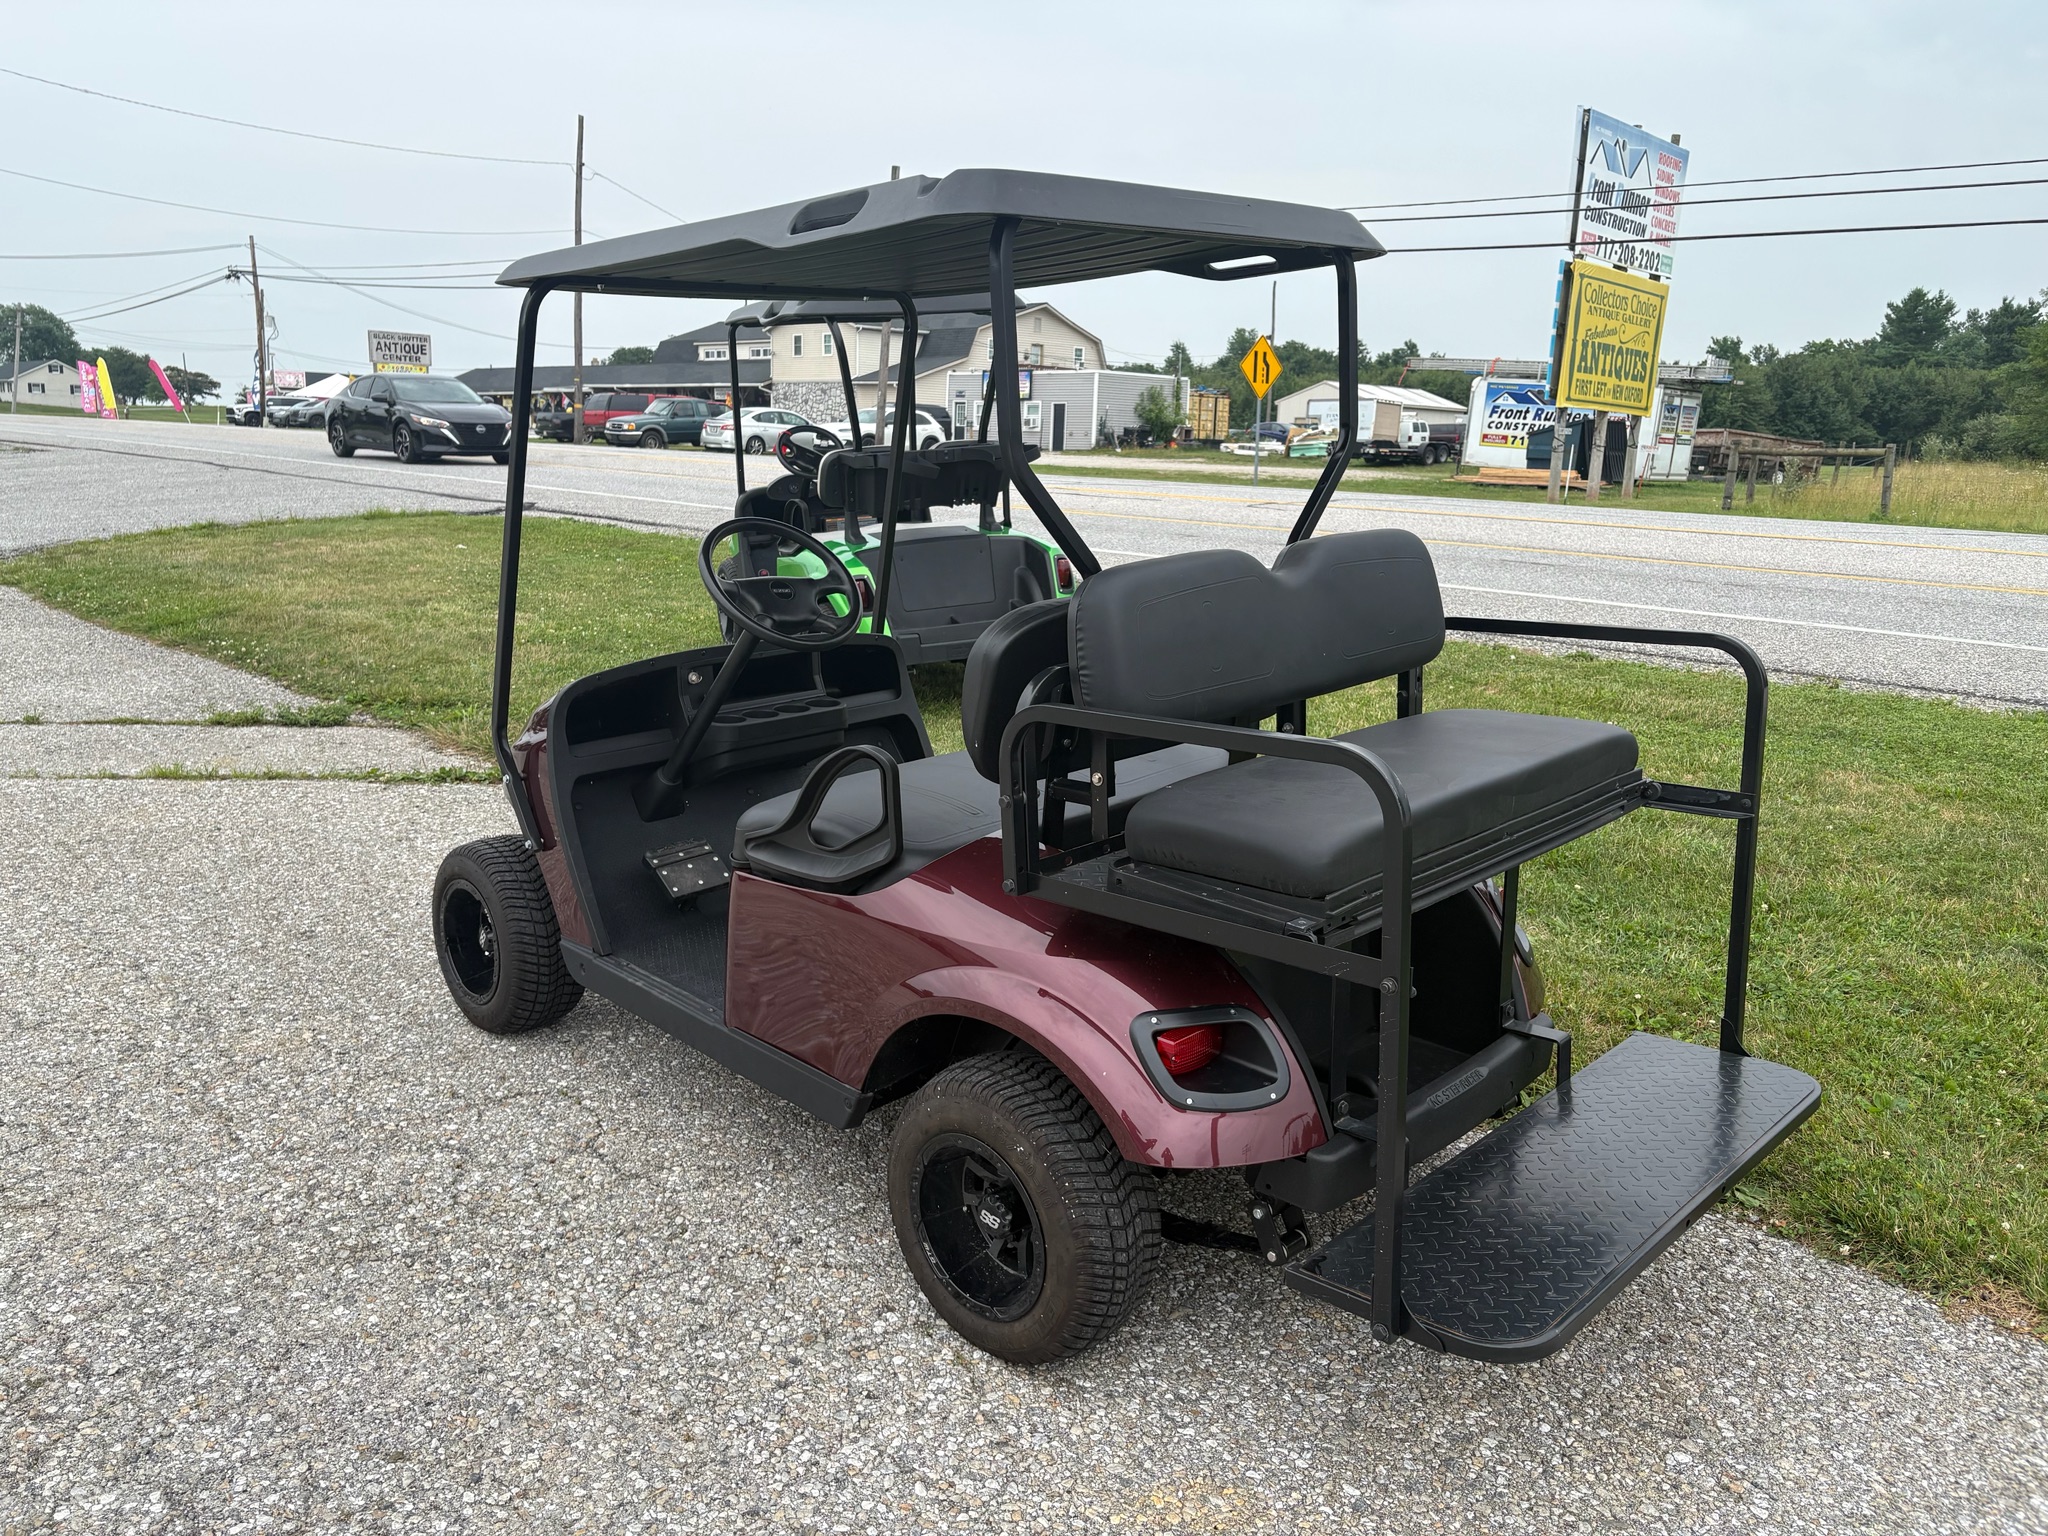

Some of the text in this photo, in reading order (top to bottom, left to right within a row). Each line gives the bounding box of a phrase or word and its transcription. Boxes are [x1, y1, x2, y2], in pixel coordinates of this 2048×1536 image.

[1658, 152, 1682, 172] ROOFING
[1656, 168, 1675, 185] SIDING
[1586, 172, 1615, 206] Front
[1655, 183, 1681, 203] WINDOWS
[1584, 205, 1647, 238] CONSTRUCTION
[1651, 215, 1676, 234] CONCRETE
[1585, 282, 1657, 319] Collectors Choice
[1587, 305, 1652, 328] ANTIQUE GALLERY
[373, 333, 428, 343] BLACK SHUTTER
[1584, 323, 1617, 341] Fabulous
[375, 341, 427, 356] ANTIQUE
[382, 353, 421, 363] CENTER
[1577, 339, 1649, 383] ANTIQUES
[1575, 379, 1593, 397] FIRST
[1593, 380, 1607, 398] LEFT
[1612, 383, 1624, 400] NEW
[1624, 385, 1643, 404] OXFORD
[1488, 405, 1530, 421] Front
